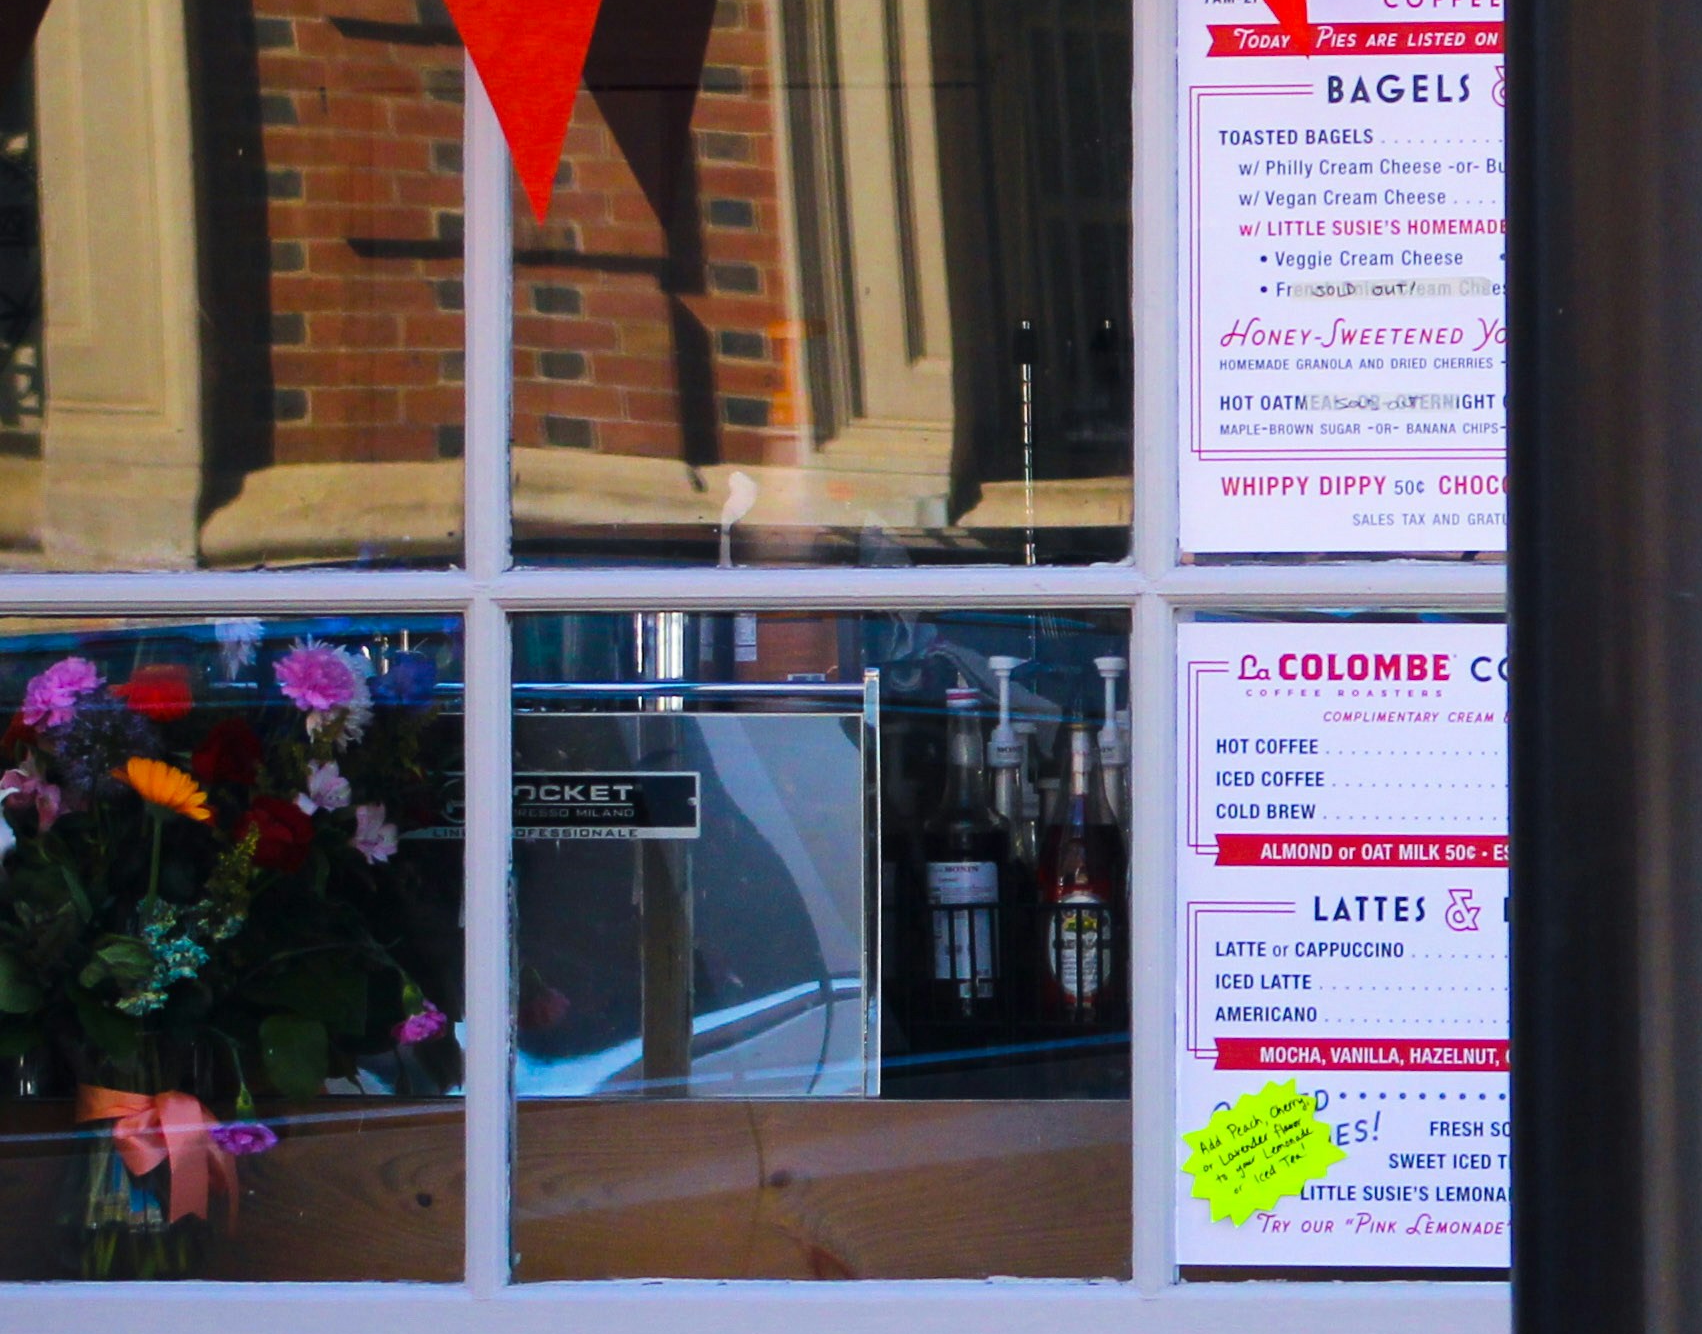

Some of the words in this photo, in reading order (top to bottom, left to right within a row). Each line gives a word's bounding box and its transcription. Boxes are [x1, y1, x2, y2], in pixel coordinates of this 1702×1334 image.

[1316, 25, 1357, 48] PIES
[1365, 32, 1398, 47] ARE
[1407, 32, 1466, 47] LISTED
[1474, 32, 1499, 46] ON
[1327, 73, 1471, 103] BAGELS
[1219, 130, 1298, 145] TOASTED
[1305, 129, 1374, 145] BAGELS
[1239, 162, 1259, 175] w/
[1266, 160, 1313, 179] Philly
[1319, 160, 1374, 175] Cream
[1380, 159, 1442, 175] Cheese
[1449, 160, 1480, 174] -or-
[1239, 192, 1259, 206] w/
[1265, 190, 1317, 210] Vegan
[1322, 190, 1378, 205] Cream
[1384, 189, 1446, 205] Cheese
[1239, 222, 1261, 237] w/
[1267, 221, 1326, 237] LITTLE
[1332, 219, 1401, 236] SUSIE'S
[1275, 251, 1332, 270] Veggie
[1340, 251, 1394, 267] Cream
[1401, 250, 1463, 266] Cheese
[1220, 317, 1464, 348] HONEY-SWEETENED
[1219, 358, 1289, 371] HOMEMADE
[1296, 357, 1353, 371] GRANOLA
[1359, 357, 1385, 370] AND
[1391, 357, 1427, 370] DRIED
[1434, 356, 1494, 370] CHERRIES
[1220, 395, 1253, 411] HOT
[1220, 423, 1314, 436] MAPLE-BROWN
[1320, 423, 1361, 436] SUGAR
[1368, 423, 1399, 435] -OR-
[1406, 422, 1457, 435] BANANA
[1221, 476, 1310, 496] WHIPPY
[1319, 475, 1387, 496] DIPPY
[1394, 479, 1425, 496] 50¢
[1353, 513, 1395, 527] SALES
[1402, 513, 1426, 526] TAX
[1432, 513, 1460, 526] AND
[1238, 654, 1271, 680] La
[1278, 653, 1451, 682] COLOMBE
[1245, 689, 1321, 698] COFFEE
[1337, 689, 1443, 698] ROASTERS
[1323, 711, 1439, 723] COMPLIMENTARY
[1448, 711, 1495, 723] CREAM
[1216, 739, 1250, 755] HOT
[1255, 739, 1319, 755] COFFEE
[1216, 772, 1255, 787] ICED
[1261, 772, 1325, 788] COFFEE
[576, 807, 635, 818] MILANO
[1216, 804, 1260, 820] COLD
[1267, 804, 1316, 820] BREW
[1260, 843, 1332, 861] ALMOND
[1338, 847, 1355, 861] or
[1361, 844, 1393, 861] OAT
[1399, 844, 1440, 861] MILK
[1445, 844, 1476, 861] 50¢
[1314, 895, 1426, 922] LATTES
[1445, 889, 1481, 931] &
[1215, 942, 1266, 958] LATTE
[1272, 945, 1288, 958] or
[1295, 942, 1404, 959] CAPPUCCINO
[1215, 974, 1254, 990] ICED
[1261, 974, 1312, 990] LATTE
[1215, 1006, 1318, 1023] AMERICANO
[1260, 1046, 1327, 1066] MOCHA,
[1330, 1047, 1404, 1066] VANILLA,
[1410, 1047, 1500, 1067] HAZELNUT,
[1429, 1121, 1484, 1137] FRESH
[1200, 1134, 1222, 1155] Add
[1203, 1164, 1213, 1173] or
[1218, 1133, 1269, 1167] Lavender
[1216, 1173, 1229, 1184] to
[1235, 1156, 1256, 1179] your
[1262, 1127, 1314, 1160] Lemonade
[1388, 1154, 1445, 1169] SWEET
[1452, 1153, 1492, 1169] ICED
[1234, 1184, 1243, 1195] or
[1254, 1164, 1277, 1184] Iced
[1300, 1186, 1356, 1201] LITTLE
[1363, 1185, 1429, 1201] SUSIE'S
[1436, 1186, 1511, 1202] LEMONA
[1257, 1213, 1291, 1234] TRY
[1301, 1220, 1334, 1233] OUR
